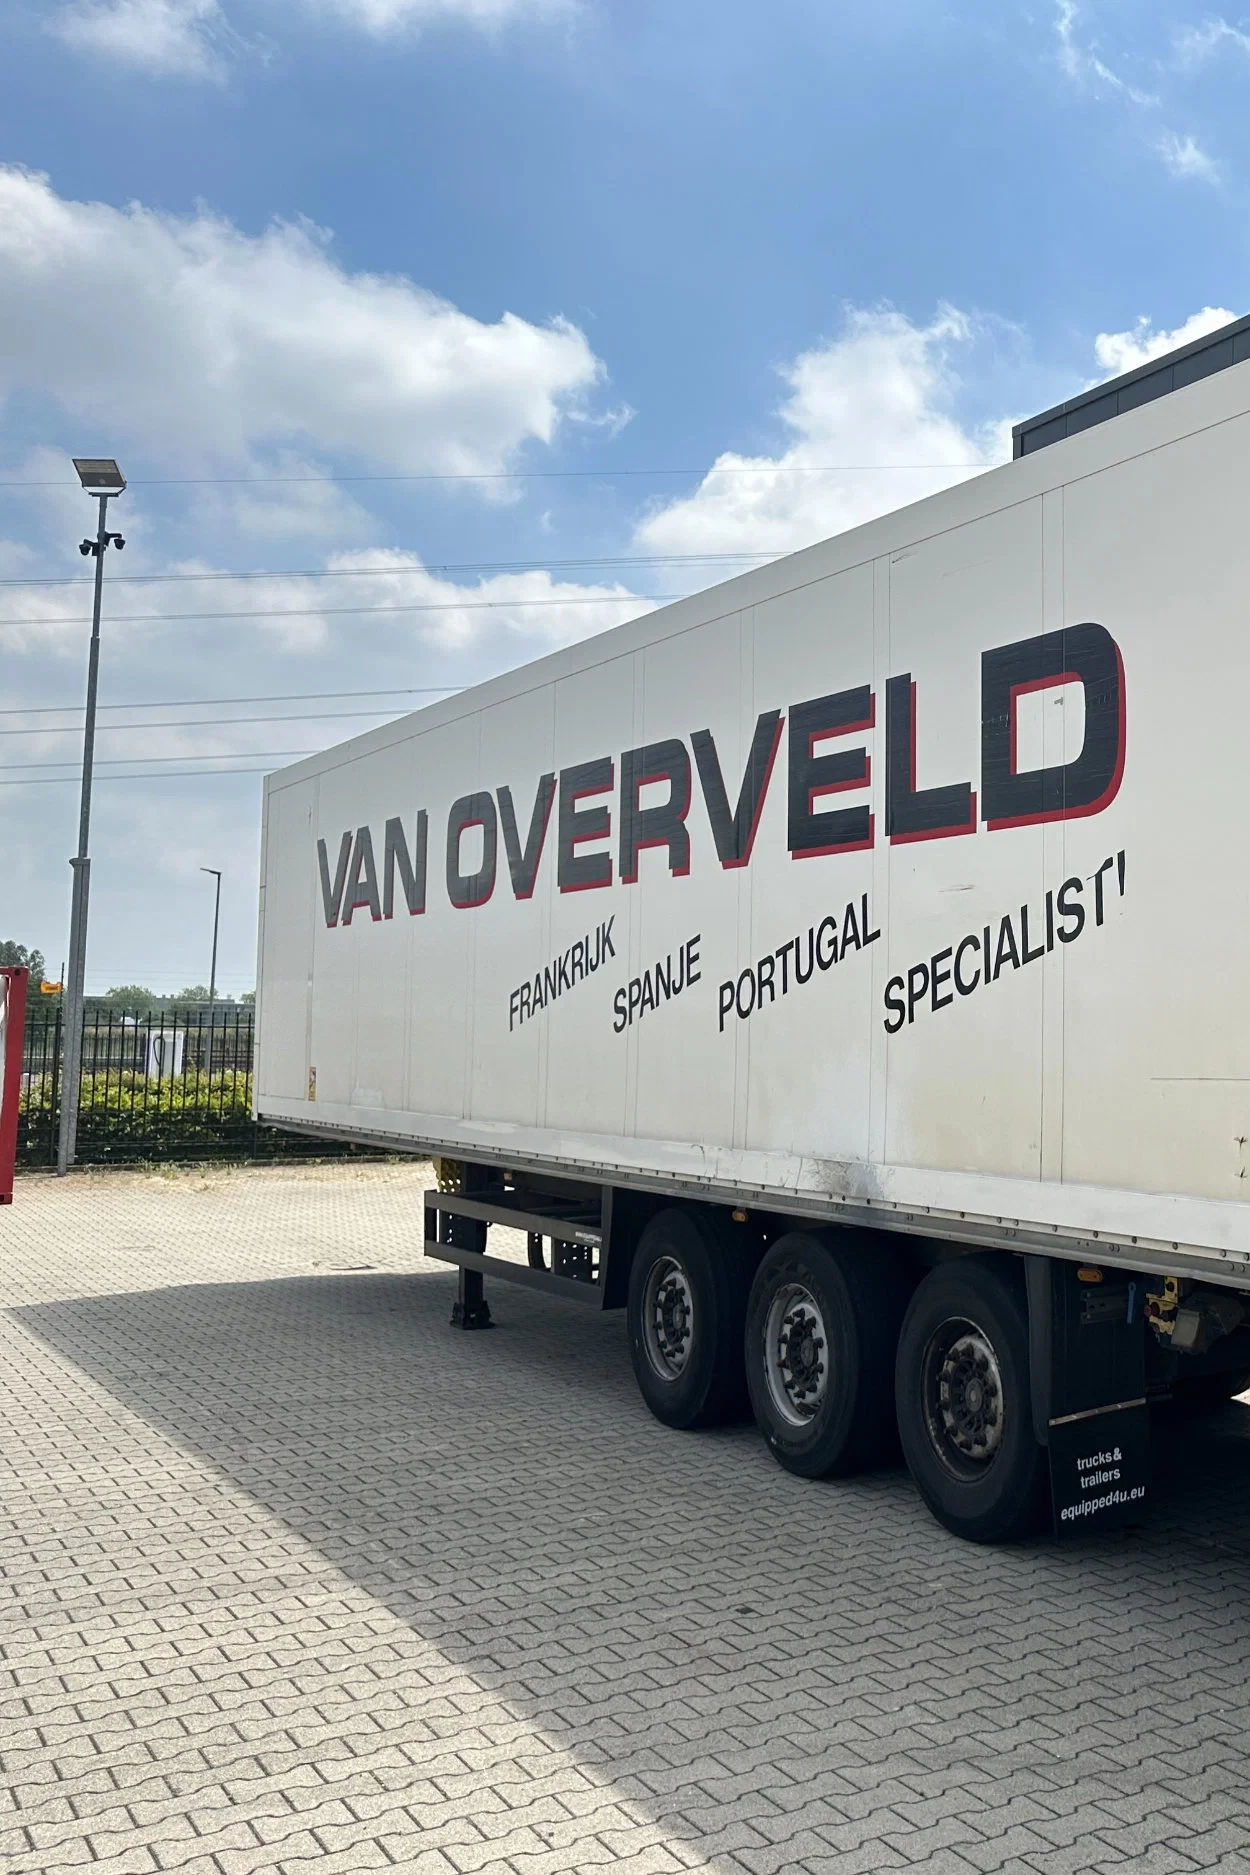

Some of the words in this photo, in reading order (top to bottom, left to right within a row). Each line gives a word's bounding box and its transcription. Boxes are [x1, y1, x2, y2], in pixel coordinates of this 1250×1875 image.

[317, 809, 428, 928] VAN
[446, 622, 1128, 910] OVERVELD
[509, 914, 617, 1032] FRANKRIJK
[613, 933, 702, 1033] SPANJE
[719, 892, 881, 1033] PORTUGAL
[1061, 1486, 1145, 1520] equipped4u.eu
[1080, 1468, 1121, 1488] trailers
